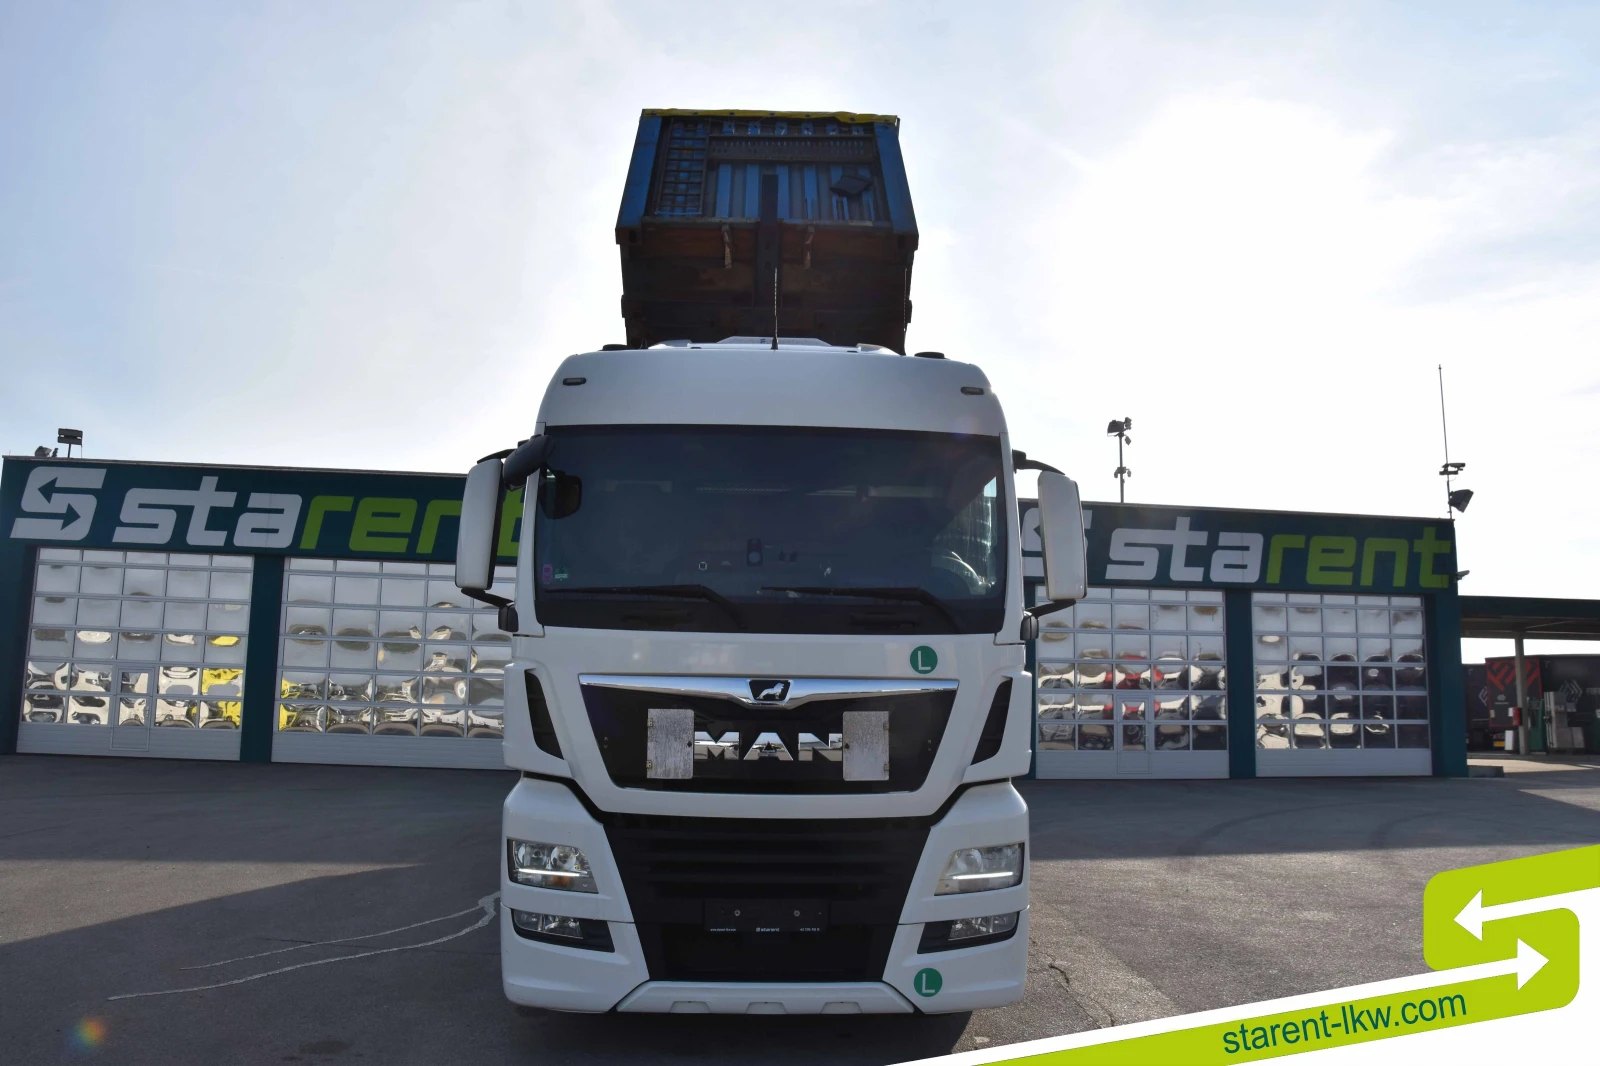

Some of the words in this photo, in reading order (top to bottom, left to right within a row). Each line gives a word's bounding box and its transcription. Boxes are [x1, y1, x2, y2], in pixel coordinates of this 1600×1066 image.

[1105, 516, 1452, 588] starent
[917, 650, 931, 670] L
[694, 731, 842, 762] MAN
[922, 972, 936, 993] L
